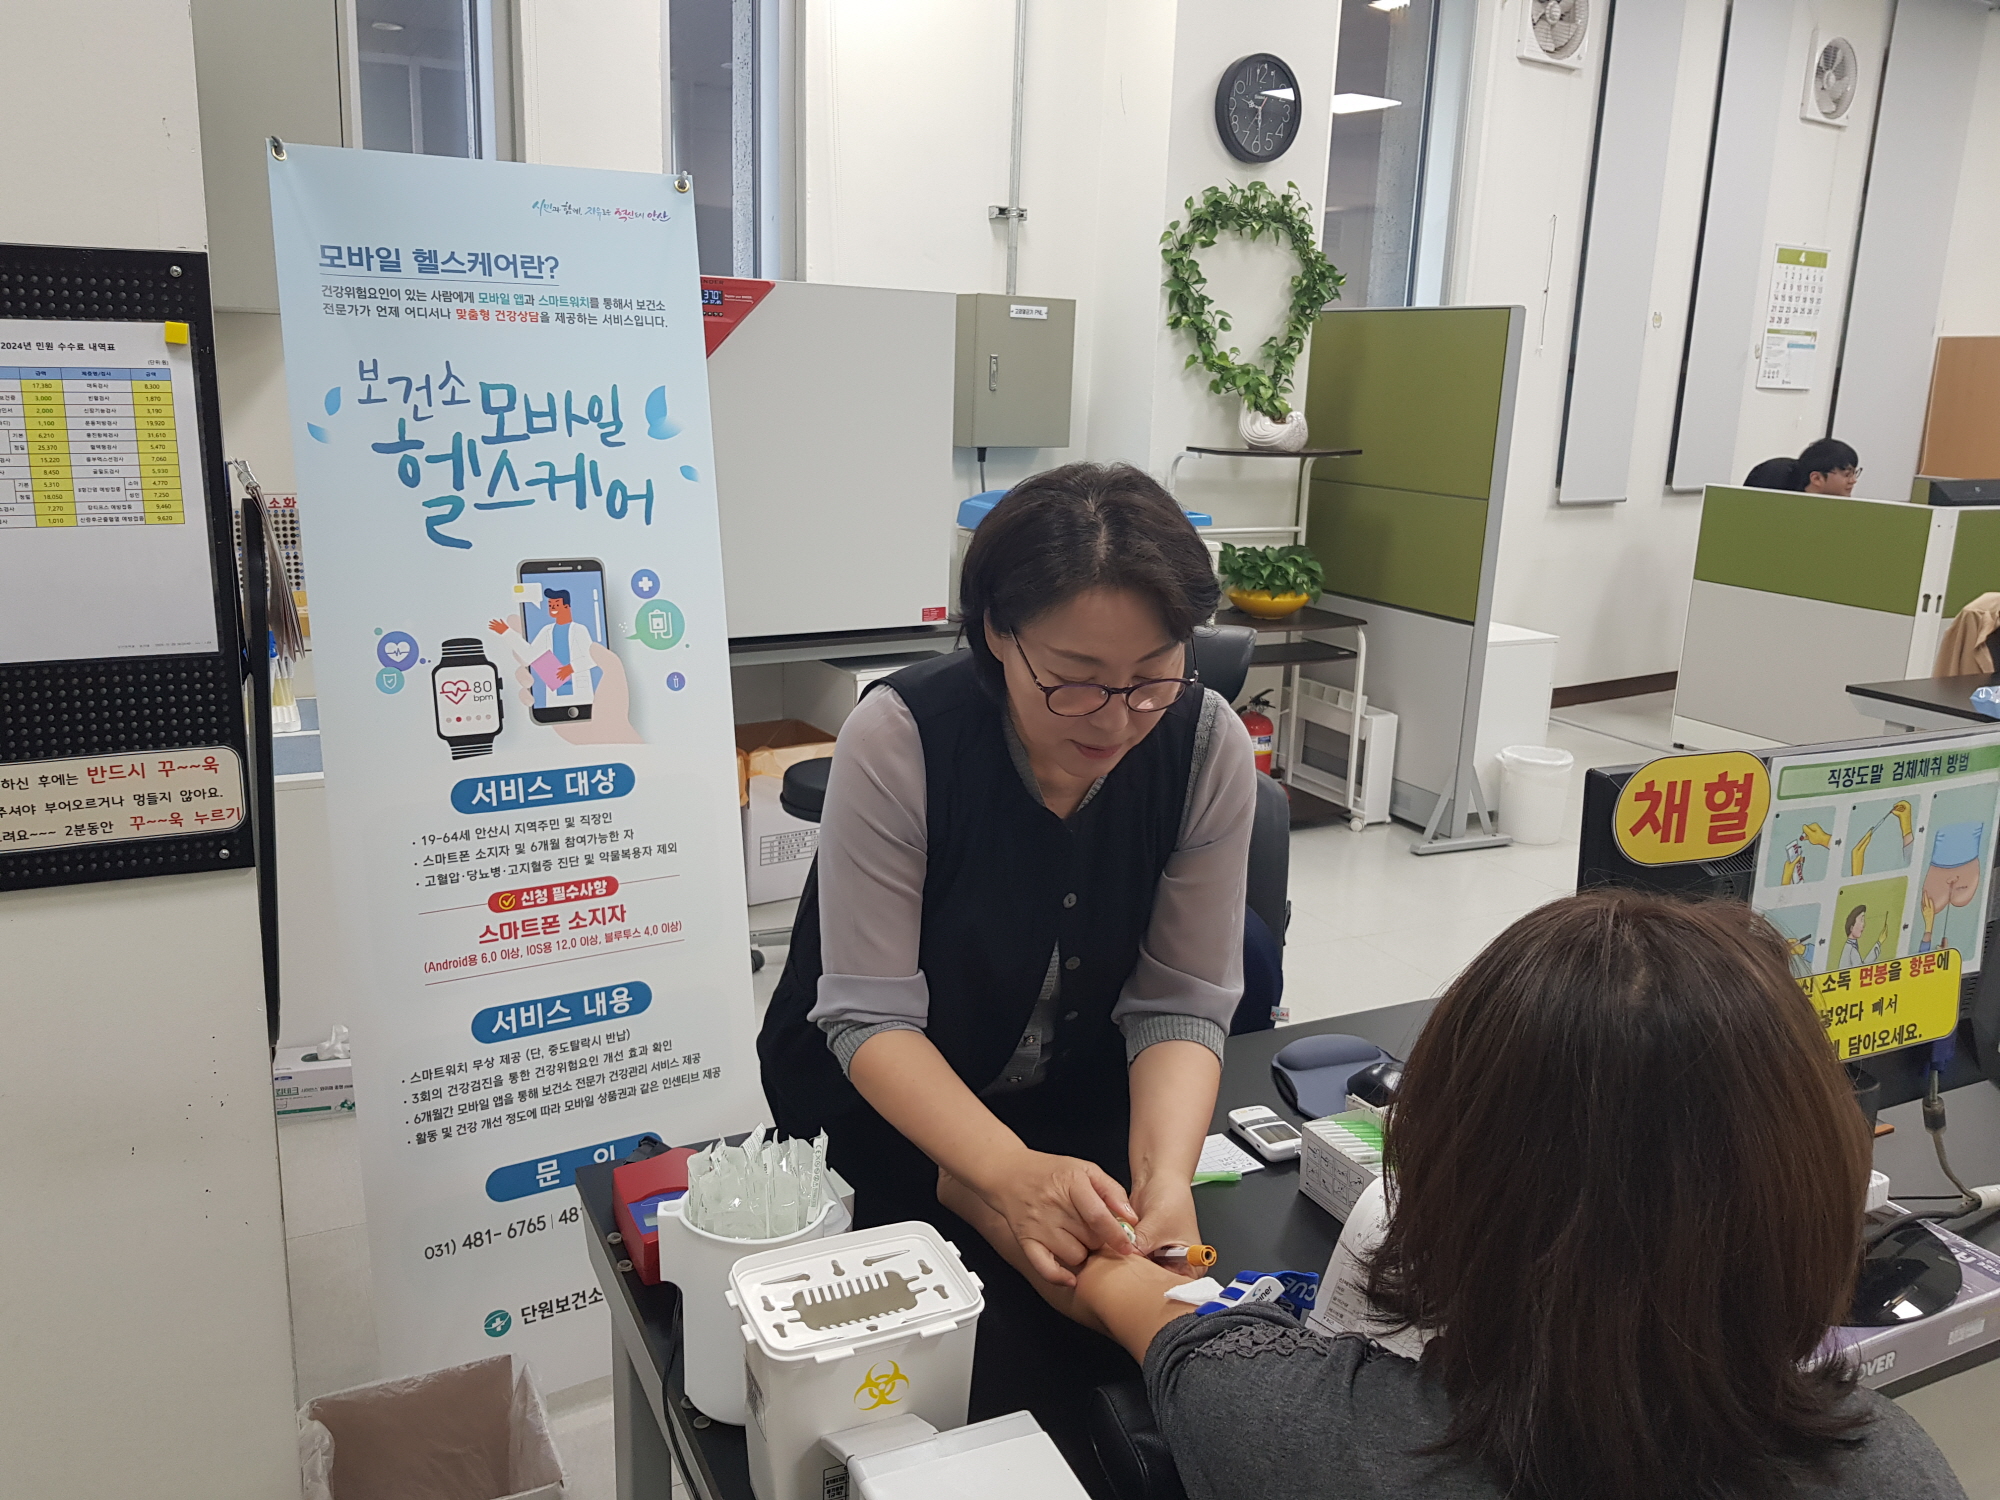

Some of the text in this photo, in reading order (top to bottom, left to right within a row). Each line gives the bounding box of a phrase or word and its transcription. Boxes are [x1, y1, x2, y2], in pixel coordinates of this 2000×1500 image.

[319, 245, 558, 278] 모바일 헬스케어란?
[1799, 252, 1806, 263] 4
[322, 285, 666, 311] 건강위험요인이 있는 사람에게 모바일 앱과 스마트워치를 통해서 보건소
[323, 303, 667, 327] 전문가가 언제 어디서나 맞춤형 건강상담을 제공하는 서비스입니다.
[0, 342, 116, 351] 2024년 민원 수수료 내역표
[357, 358, 627, 448] 보건소 모바일
[371, 418, 655, 550] 헬스케어
[472, 680, 492, 694] 80
[473, 693, 494, 703] bpm
[1, 777, 29, 790] 하신
[38, 773, 79, 788] 후에는
[87, 762, 146, 784] 반드시
[472, 768, 615, 806] 서비스 대상
[1827, 752, 1970, 788] 직장도말 검체채취 방법
[44, 795, 125, 815] 부어오르거나
[133, 791, 172, 807] 멍들지
[179, 787, 224, 803] 않아요.
[1629, 770, 1755, 845] 채혈
[64, 821, 114, 837] 2분동안
[194, 807, 241, 825] 누르기
[422, 812, 611, 845] 19-64세 안산시 지역주민 및 직장인
[423, 829, 633, 866] 스마트폰 소지자 및 6개월 참여가능한 자
[558, 856, 578, 868] 진단
[584, 853, 594, 865] 및
[599, 846, 651, 862] 약물복용자
[657, 842, 676, 854] 제외
[520, 880, 608, 907] 신청 필수사항
[479, 904, 626, 944] 스마트폰 소지자
[424, 954, 477, 973] (Android용
[481, 951, 496, 963] 6.0
[500, 947, 522, 959] 이상,
[556, 938, 576, 950] 12.0
[580, 935, 600, 946] 이상,
[604, 928, 640, 942] 블루투스
[644, 924, 658, 935] 4.0
[661, 920, 681, 932] 이상)
[1822, 971, 1851, 993] 소독
[1860, 961, 1902, 988] 면봉을
[1909, 951, 1949, 977] 항문에
[492, 987, 632, 1033] 서비스 내용
[410, 1029, 630, 1083] 스마트워치 무상 제공 (단, 중도탈락시 반납)
[1848, 1023, 1922, 1056] 담아오세요.
[412, 1040, 671, 1103] 3회의 건강검진을 통한 건강위험요인 개선 효과 확인
[414, 1053, 700, 1124] 6개월간 모바일 앱을 통해 보건소 전문가 건강관리 서비스 제공
[415, 1067, 720, 1144] 활동 및 건강 개선 정도에 따라 모바일 상품권과 같은 인센티브 제공
[536, 1159, 561, 1188] 문
[424, 1239, 457, 1260] 031)
[507, 1214, 546, 1239] 6765
[521, 1287, 603, 1324] 단원보건소
